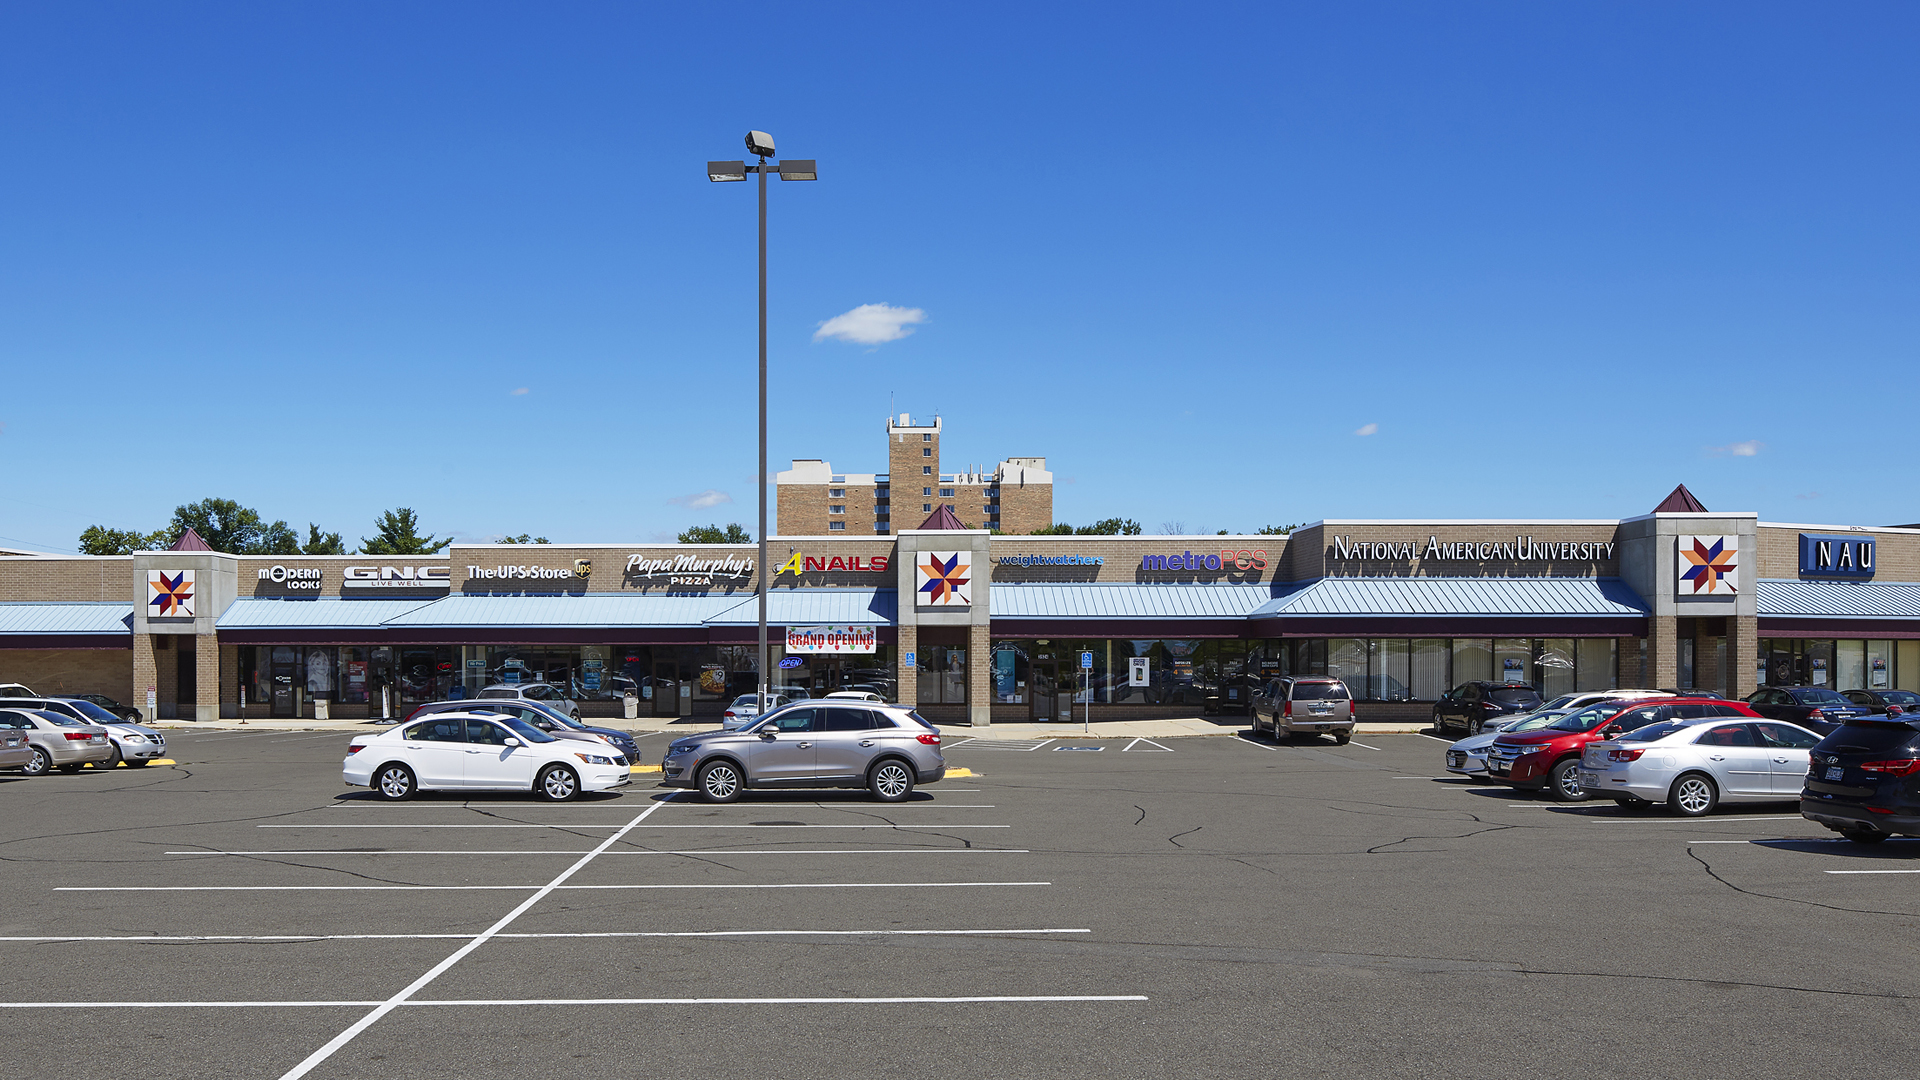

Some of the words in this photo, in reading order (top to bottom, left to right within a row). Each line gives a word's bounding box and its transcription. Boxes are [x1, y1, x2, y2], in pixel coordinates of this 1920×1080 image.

[1333, 535, 1420, 560] NATIONAL
[1820, 541, 1872, 568] NAU
[626, 553, 672, 579] Papa
[672, 553, 754, 580] Murphy's
[776, 552, 803, 576] A
[805, 556, 889, 572] NAILS
[1000, 554, 1104, 568] weightwatchers
[1142, 549, 1268, 570] metroPCS
[343, 566, 450, 579] GNC
[467, 565, 493, 579] The
[497, 565, 527, 579] UPS
[530, 565, 568, 579] Store
[575, 563, 591, 577] ups
[287, 581, 321, 594] LOOKS
[670, 577, 711, 585] PIZZA
[788, 633, 825, 646] GRAND
[827, 633, 874, 646] OPENING
[781, 659, 800, 667] OPEN
